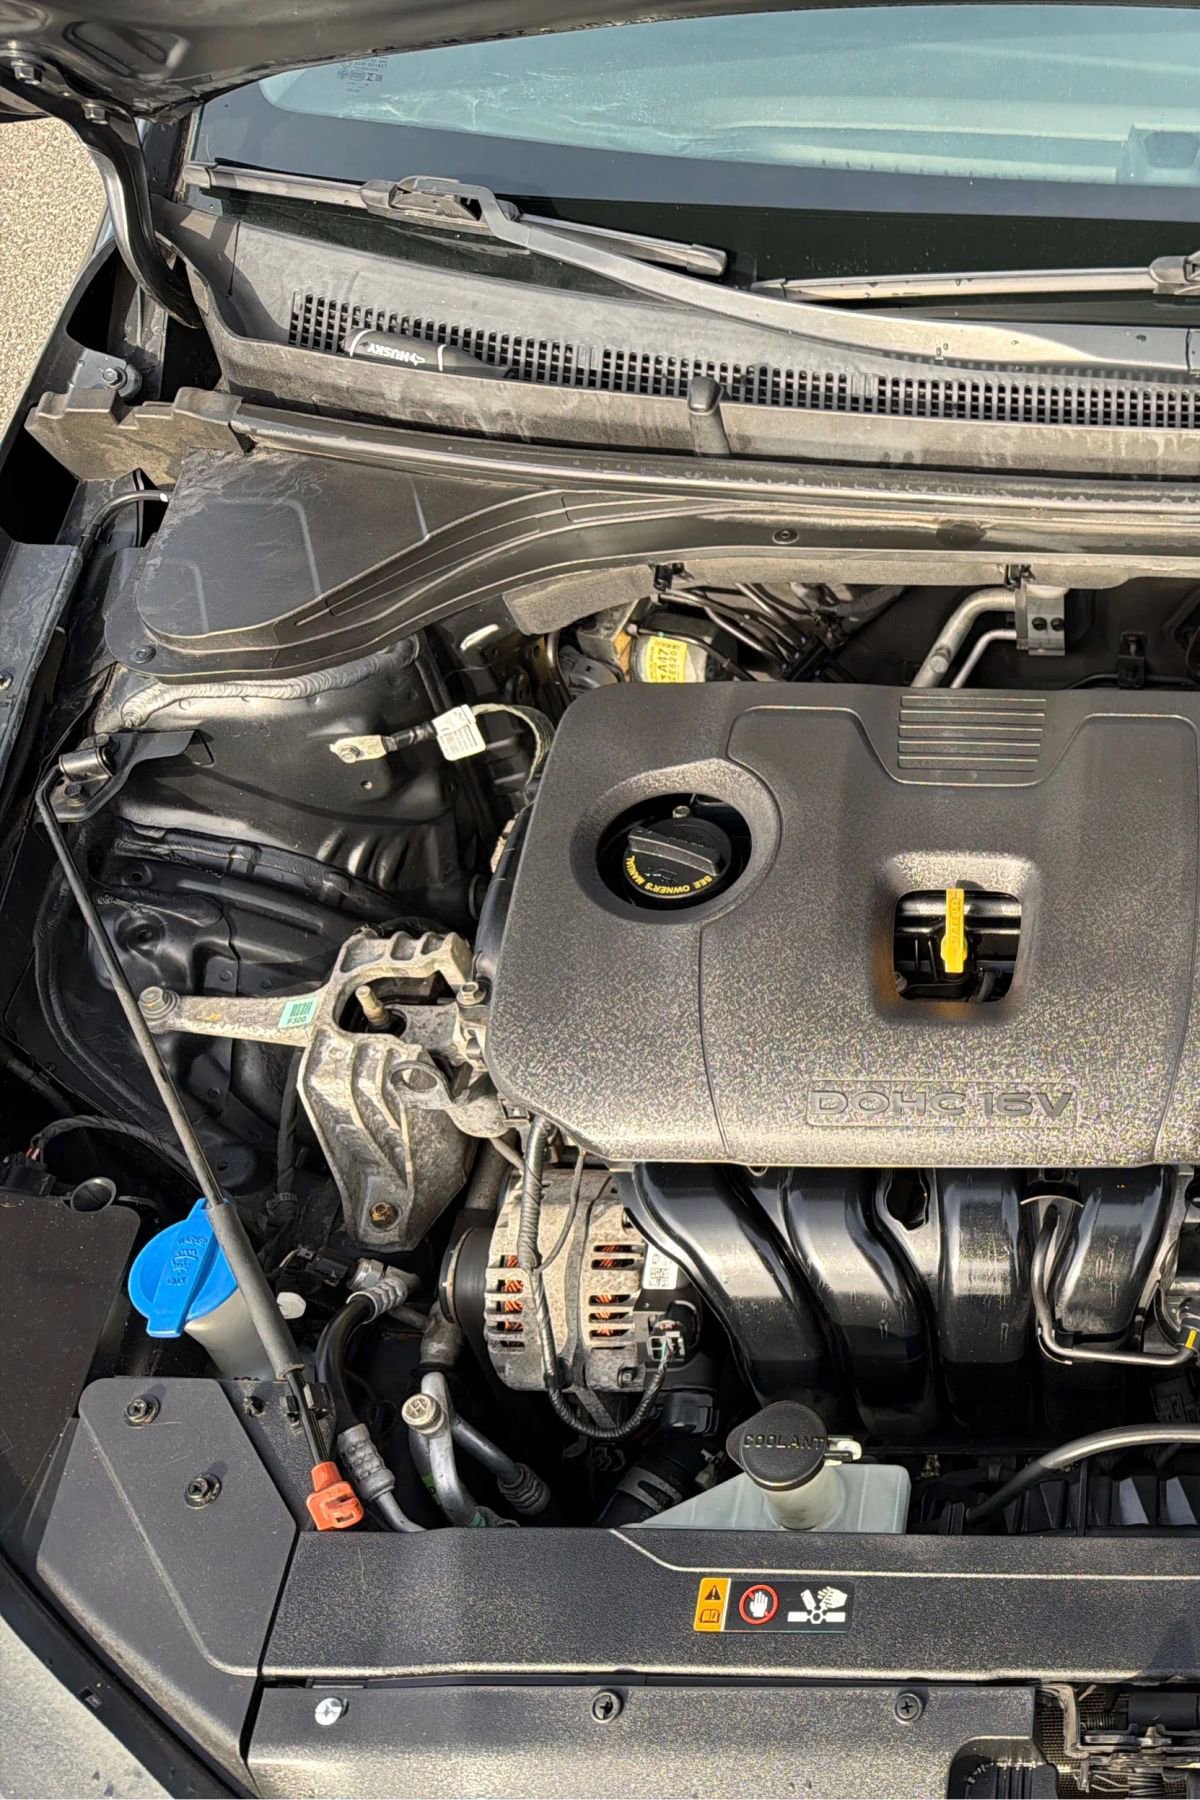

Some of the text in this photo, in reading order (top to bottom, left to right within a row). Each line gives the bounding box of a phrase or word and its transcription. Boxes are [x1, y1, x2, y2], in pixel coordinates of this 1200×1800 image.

[367, 343, 410, 362] HUSKY
[626, 855, 713, 894] SEE OWNER'S MANUAL
[810, 1090, 1073, 1118] DOHC 16V
[744, 1434, 825, 1450] COOLANT
